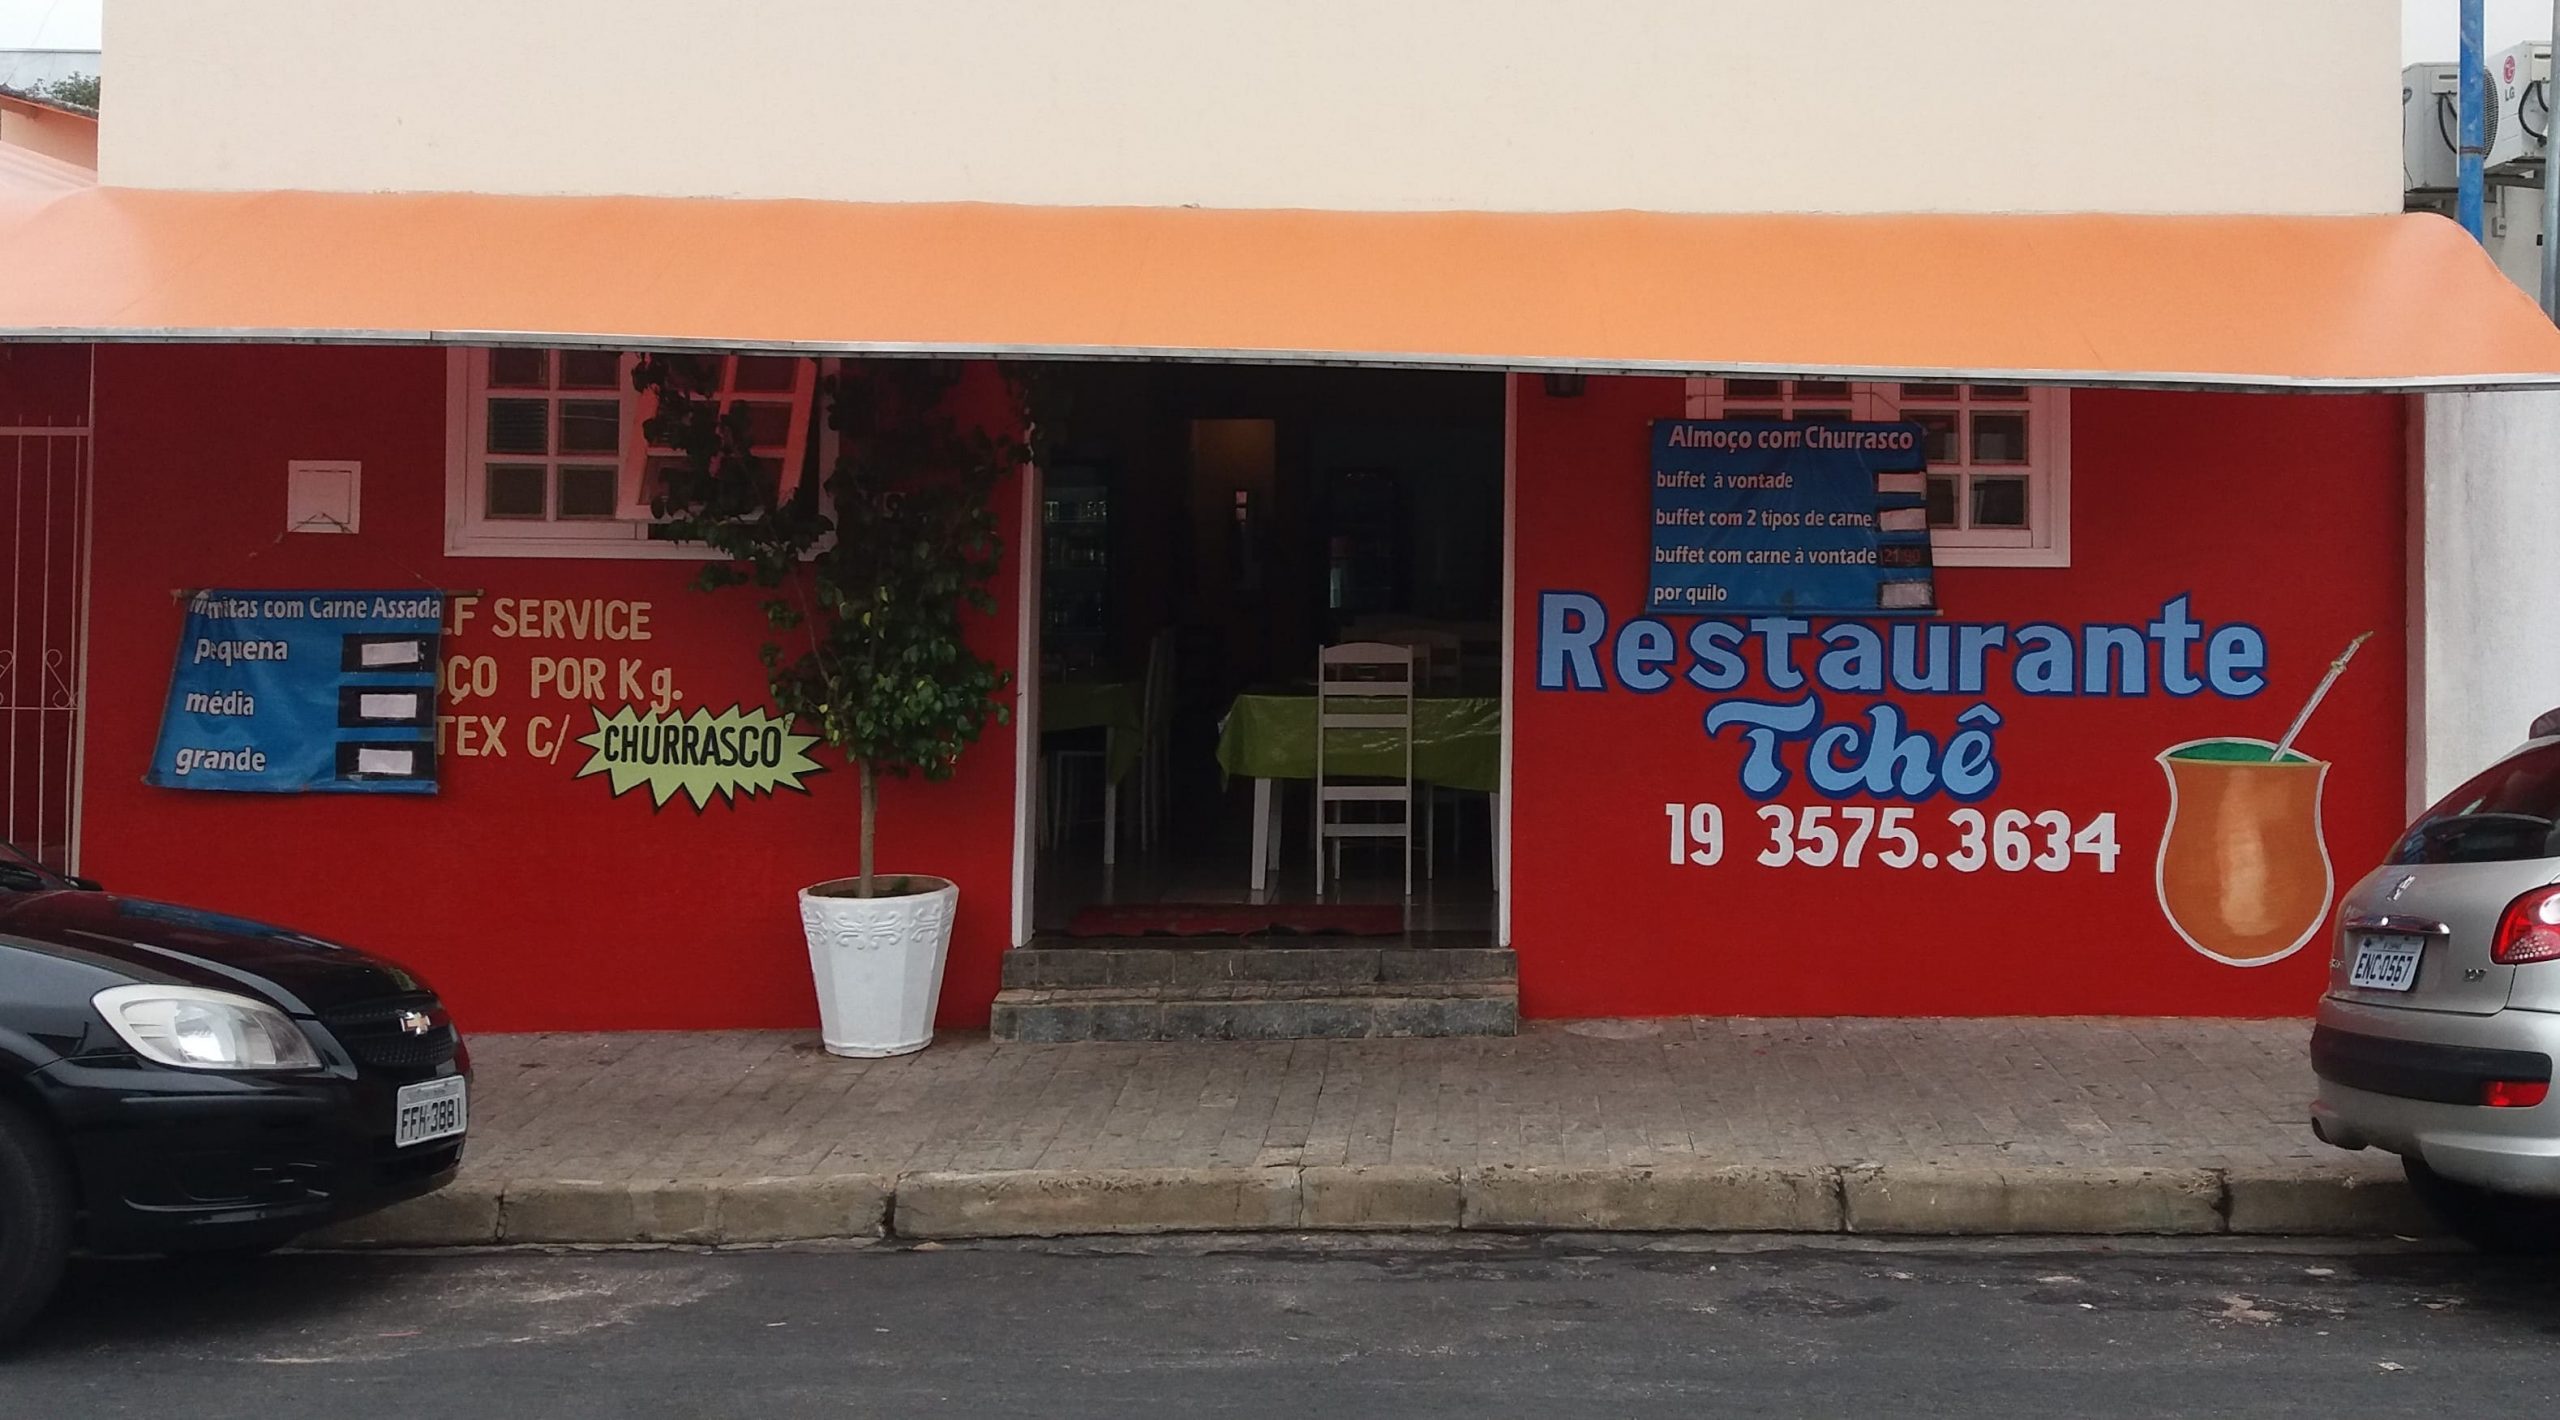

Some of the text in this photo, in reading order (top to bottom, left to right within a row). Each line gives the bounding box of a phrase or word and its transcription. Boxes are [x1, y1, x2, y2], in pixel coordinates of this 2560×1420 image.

[2504, 86, 2516, 102] LG
[1668, 424, 1914, 453] Almoço com Churrasco
[1656, 470, 1706, 489] buffet
[1728, 471, 1794, 490] vontade
[1655, 507, 1874, 531] buffet com 2 tipos de carne
[1654, 545, 1705, 564] buffet
[1708, 548, 1742, 563] com
[1746, 549, 1792, 564] carne
[1809, 547, 1878, 565] vontade
[264, 598, 304, 619] com
[309, 597, 367, 620] Carne
[372, 597, 440, 619] Assada
[1654, 583, 1728, 605] por quilo
[492, 597, 653, 641] SERVICE
[194, 638, 288, 666] pequena
[1536, 592, 2268, 697] Restaurante
[530, 656, 606, 701] POR
[618, 657, 684, 715] Kg.
[185, 690, 255, 716] média
[526, 714, 571, 766] C/
[603, 723, 783, 769] CHURRASCO
[1703, 694, 2004, 801] Tchê
[175, 747, 267, 776] grande
[1666, 802, 2121, 874] 19 3575.3634
